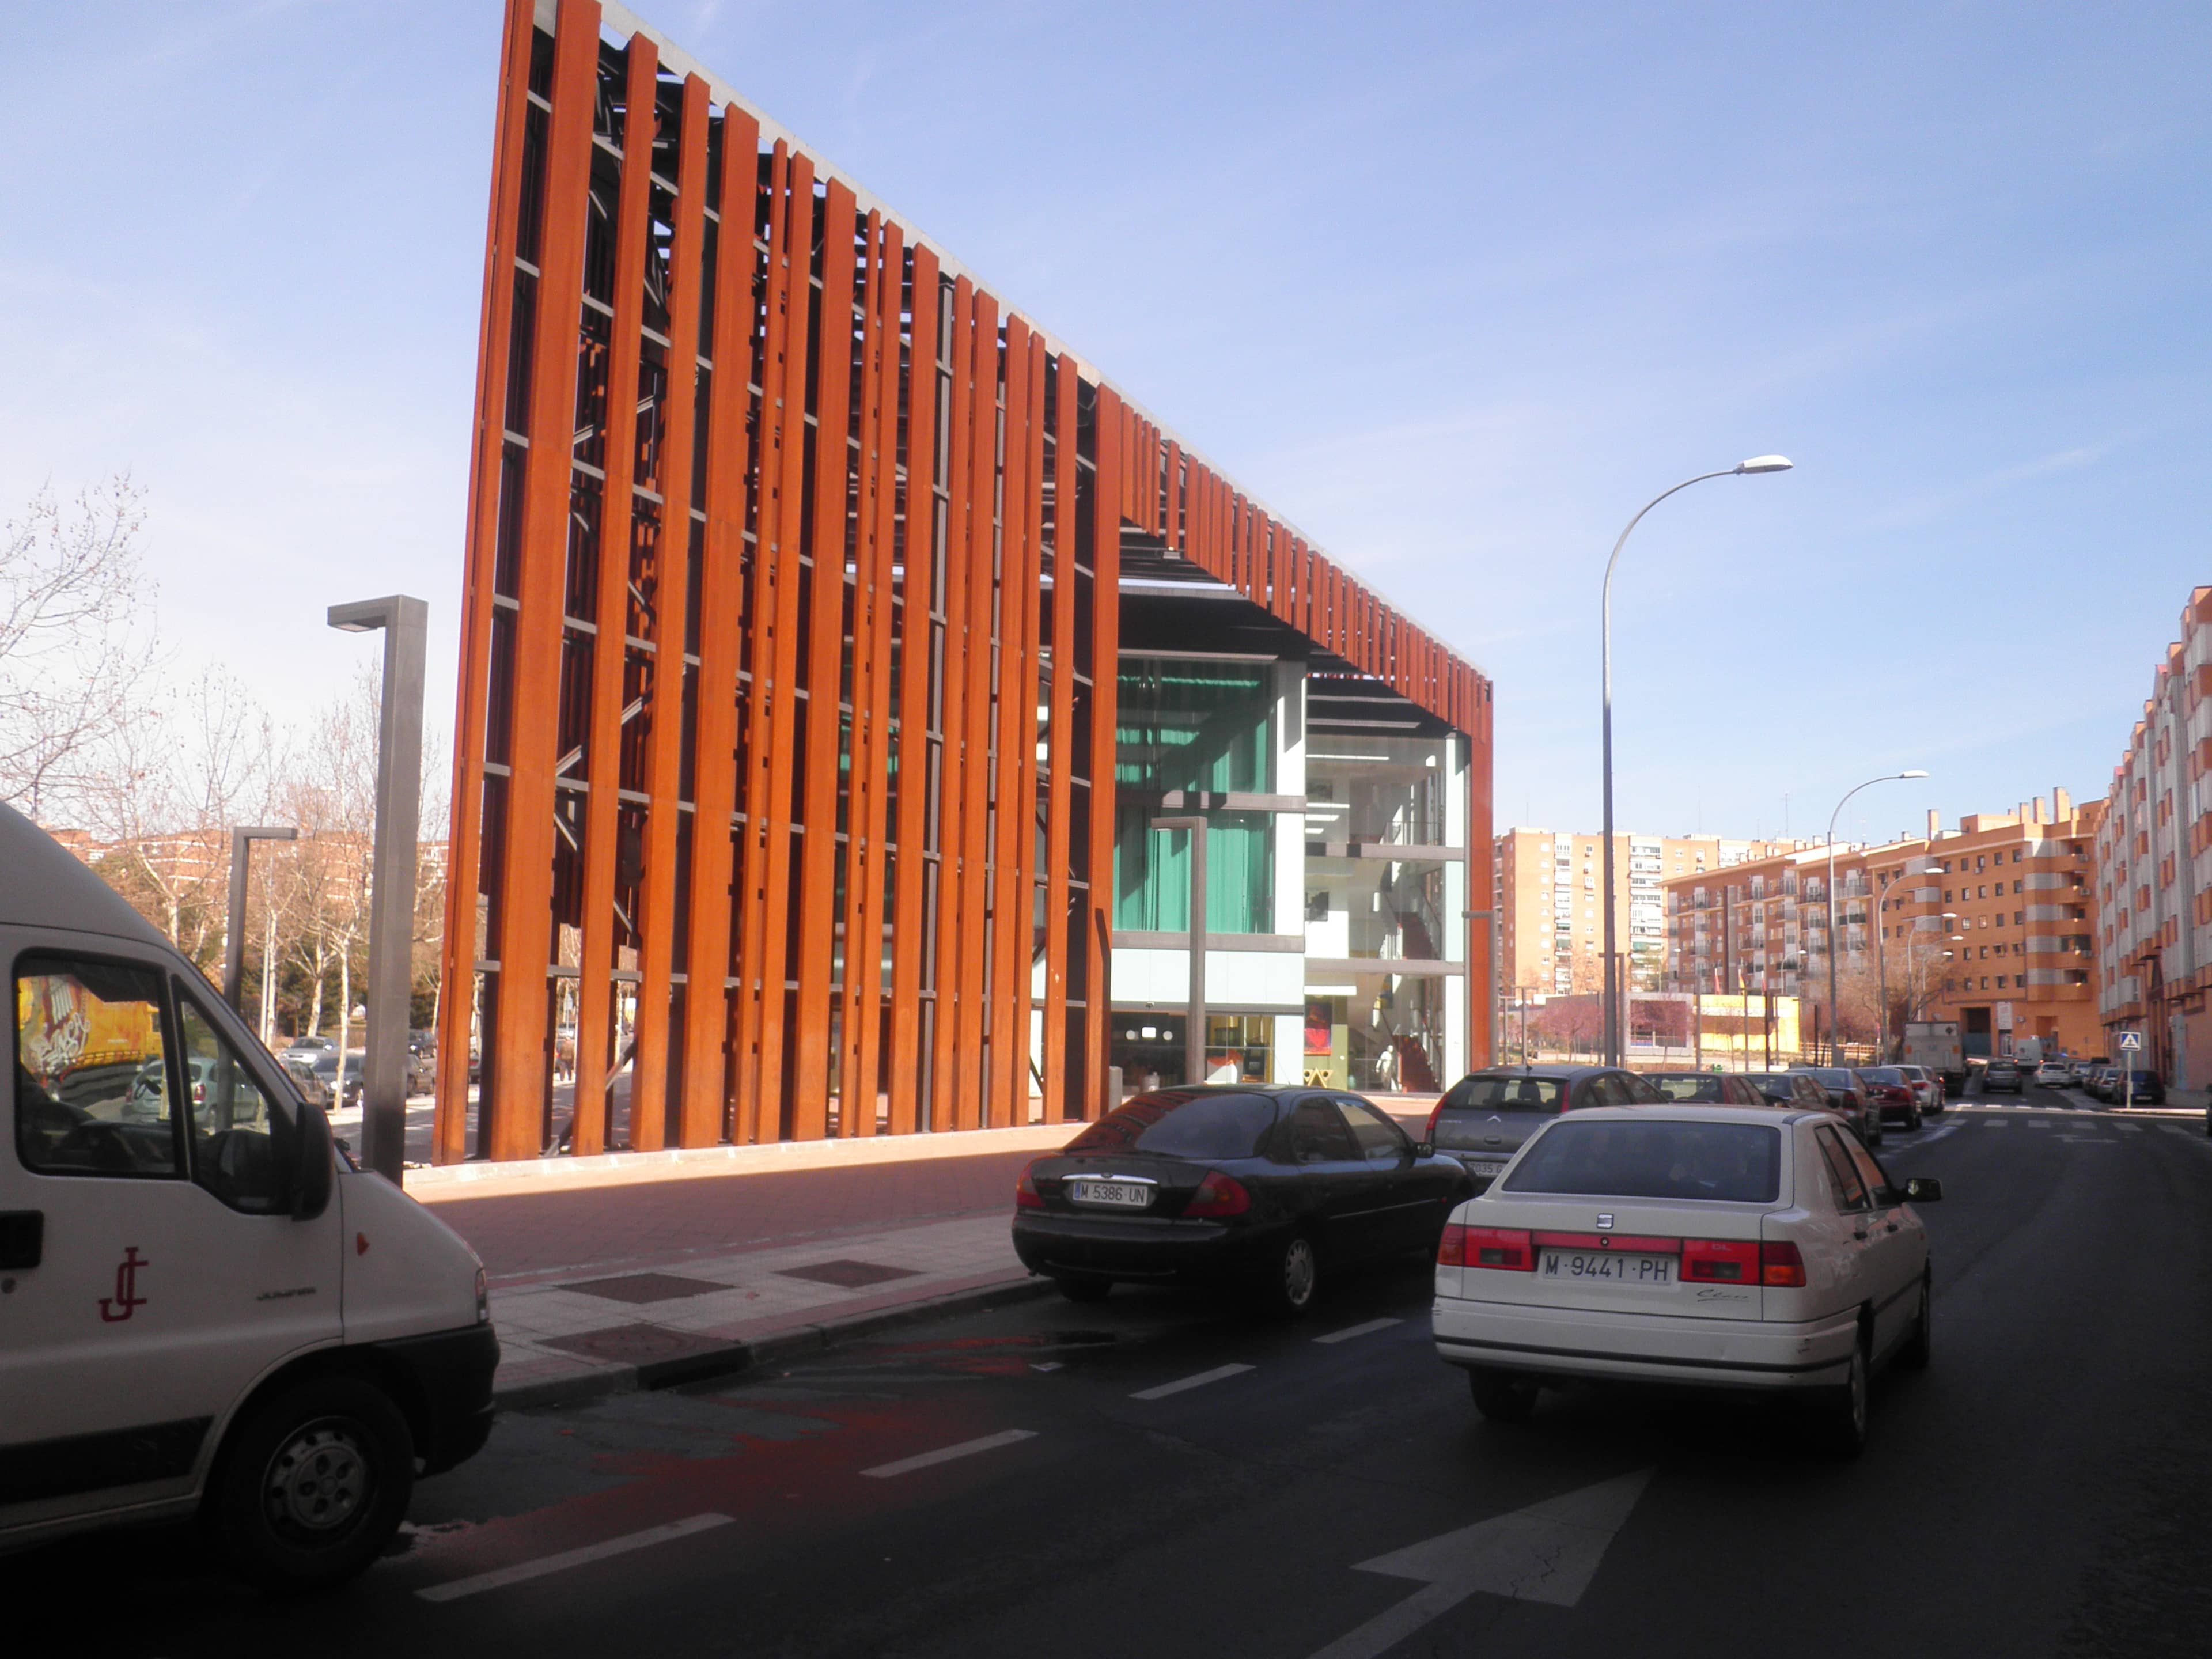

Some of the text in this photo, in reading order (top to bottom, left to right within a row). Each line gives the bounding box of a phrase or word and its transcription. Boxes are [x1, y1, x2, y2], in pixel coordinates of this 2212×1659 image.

[1081, 1184, 1145, 1203] M 5386 UN
[1546, 1255, 1669, 1281] M 9441 PH
